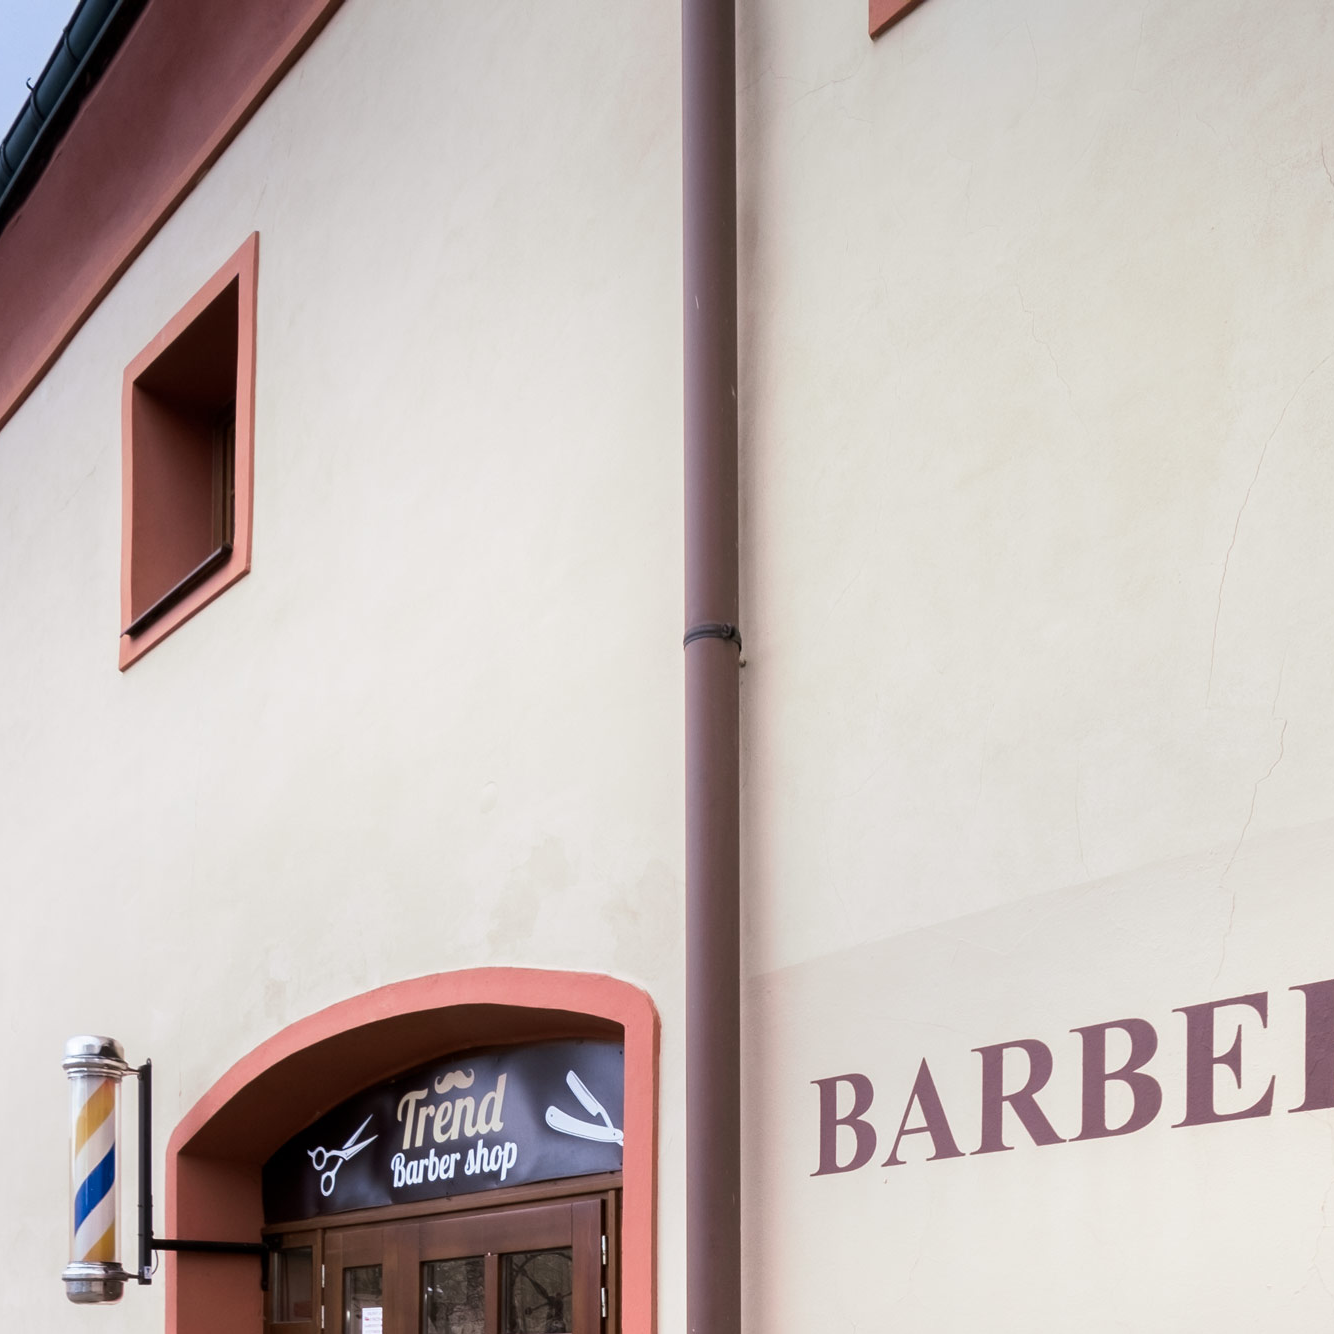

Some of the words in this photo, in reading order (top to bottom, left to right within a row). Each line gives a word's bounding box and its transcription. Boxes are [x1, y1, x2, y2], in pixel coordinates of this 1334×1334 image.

[397, 1072, 507, 1150] Trend
[391, 1148, 461, 1188] Barber
[464, 1138, 518, 1181] shop
